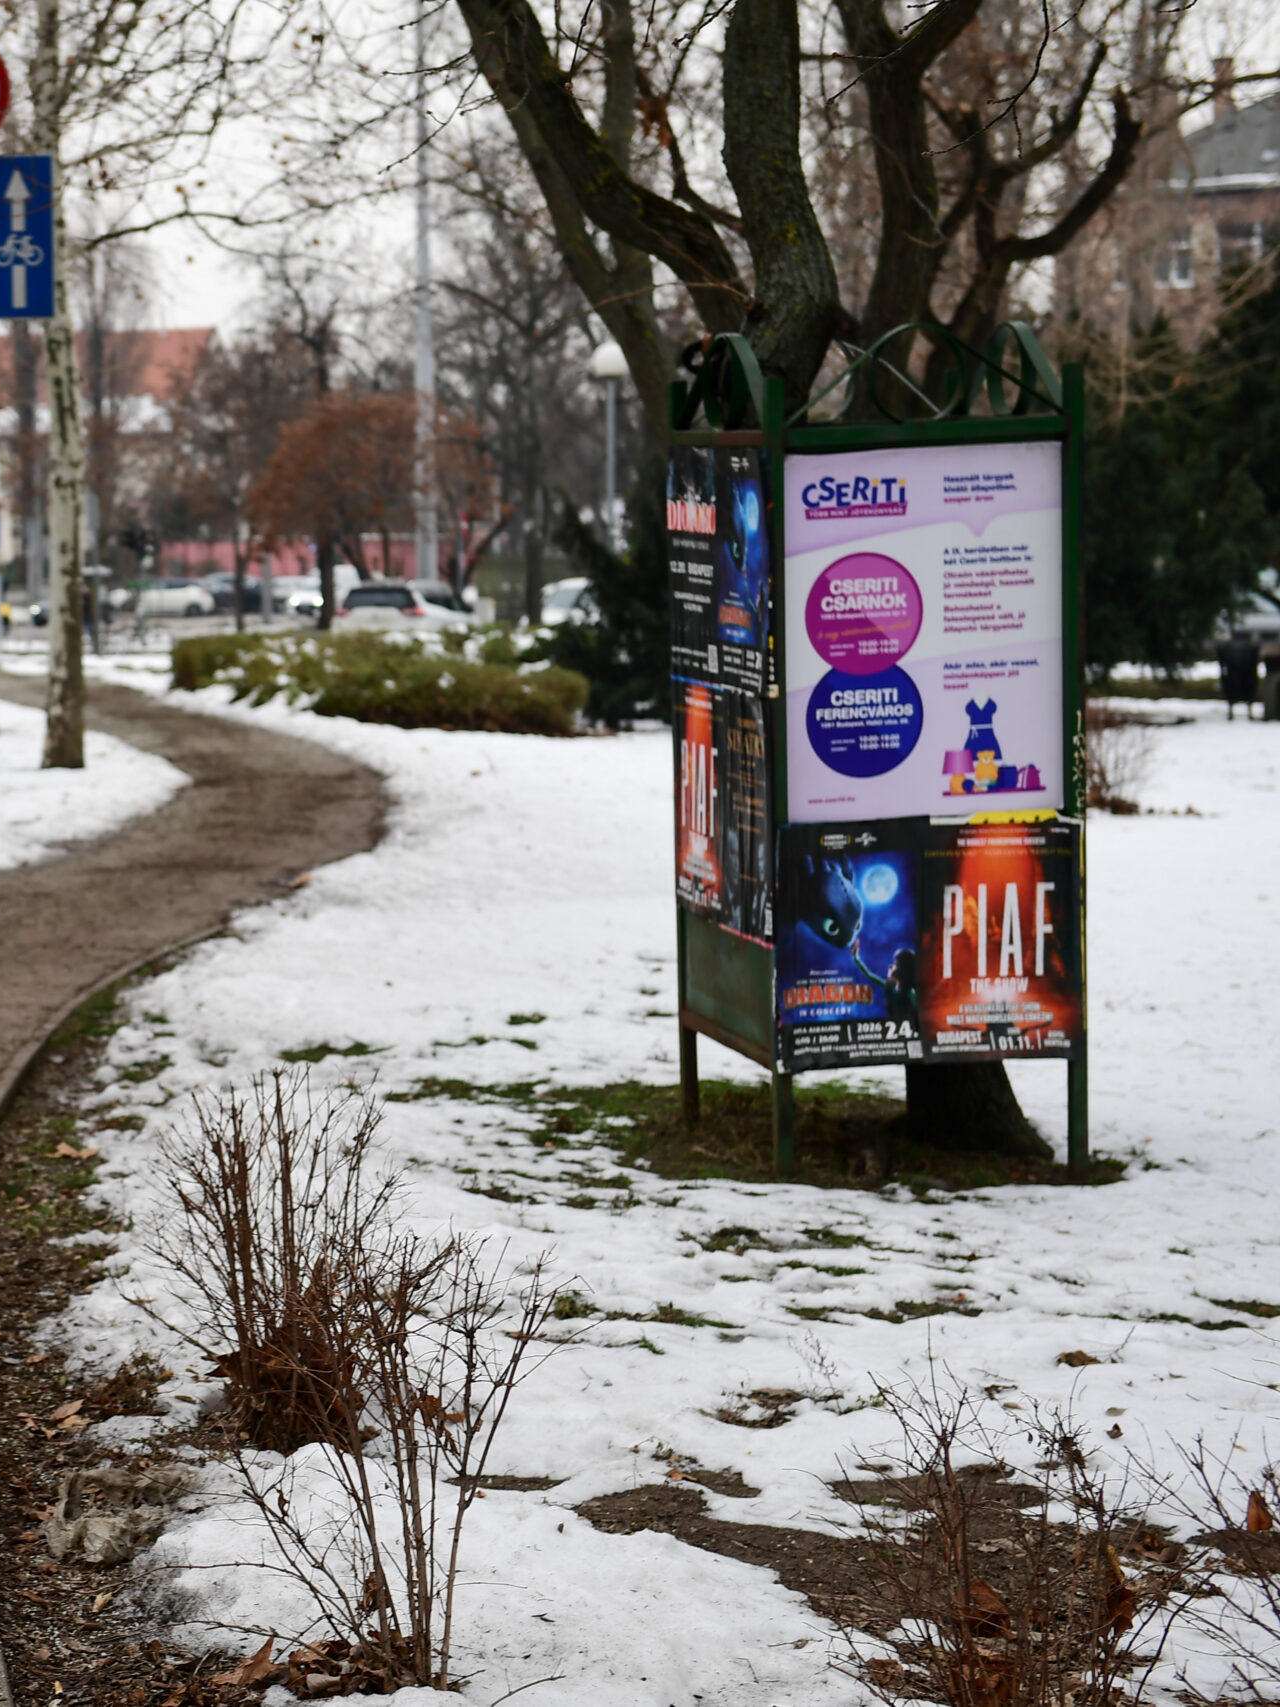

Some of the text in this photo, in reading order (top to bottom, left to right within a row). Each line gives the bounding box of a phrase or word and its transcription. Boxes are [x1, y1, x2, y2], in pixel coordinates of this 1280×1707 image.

[829, 577, 898, 595] CSERITI
[821, 593, 908, 612] CSARNOK
[831, 688, 898, 707] CSERITI
[816, 703, 914, 722] FERENCVÁROS
[681, 739, 719, 837] PIAF
[943, 882, 1055, 979] PIAF
[970, 977, 1029, 994] THE SHOW
[784, 984, 872, 1010] DRAGON
[809, 1006, 852, 1018] CONCERT
[885, 1020, 919, 1040] 24.
[936, 1031, 982, 1045] BUDAPEST
[998, 1035, 1035, 1051] 01.11.
